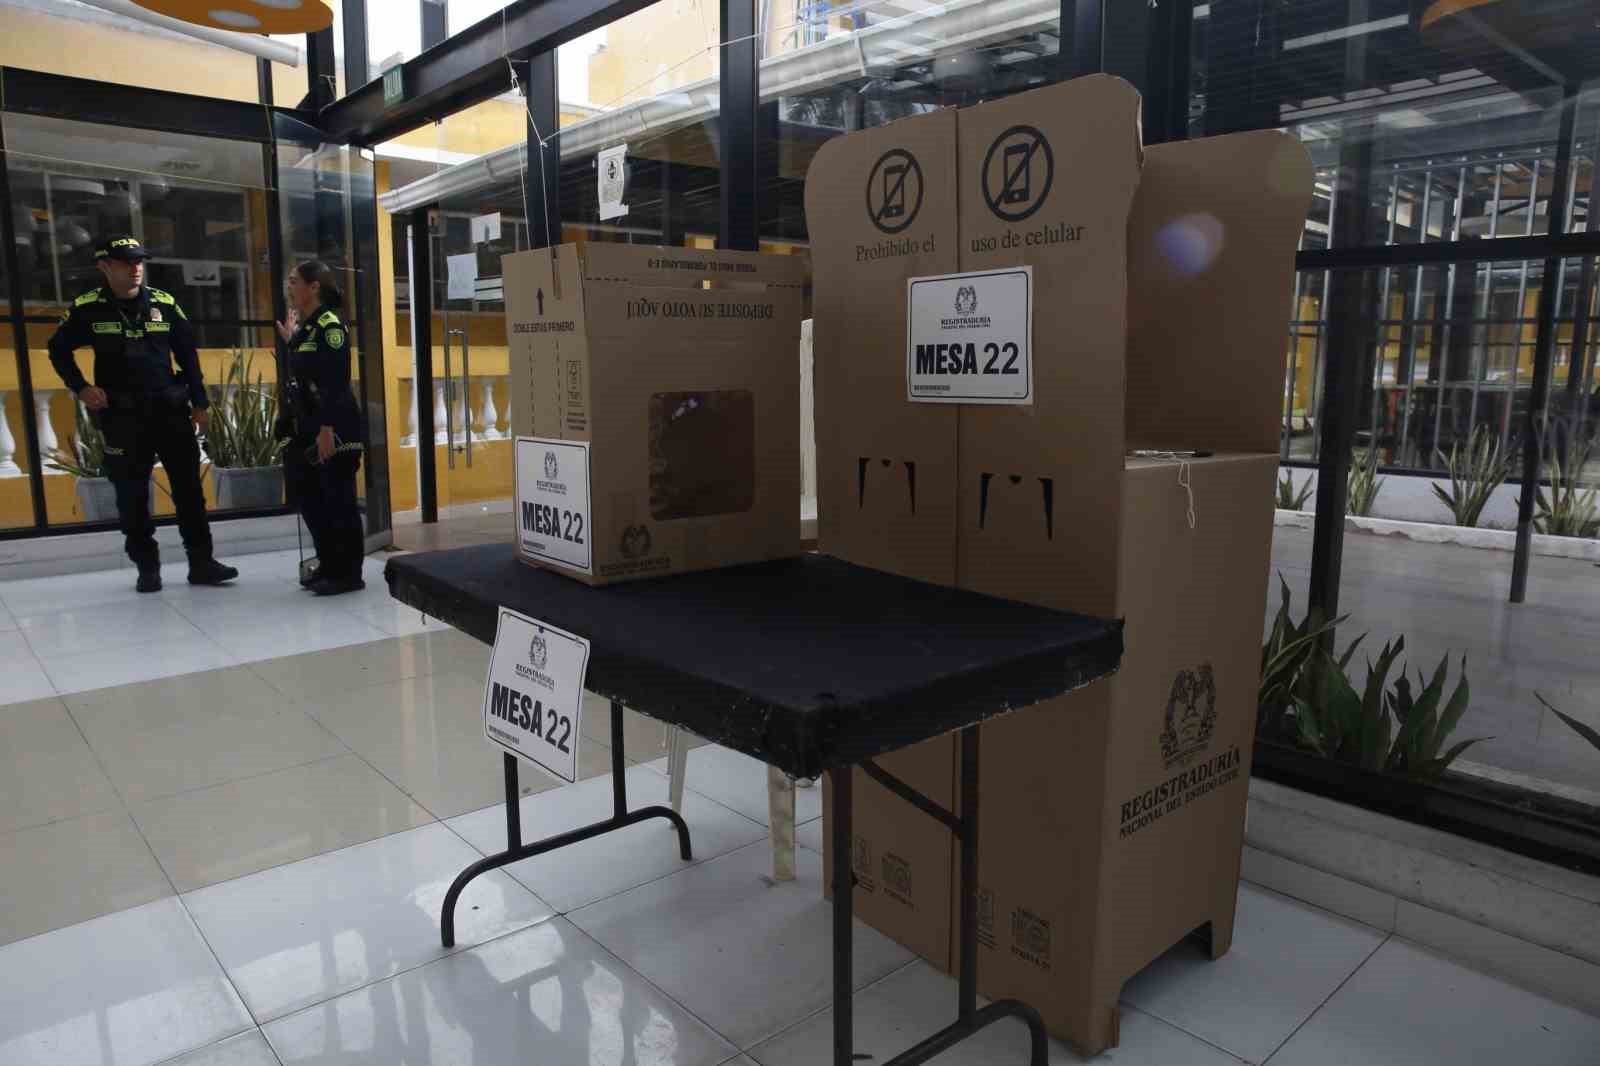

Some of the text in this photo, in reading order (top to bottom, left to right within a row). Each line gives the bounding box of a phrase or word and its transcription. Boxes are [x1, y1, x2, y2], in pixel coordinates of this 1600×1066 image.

[856, 222, 1086, 262] Prohibido el uso de celular
[662, 302, 697, 318] VOTO
[699, 303, 715, 318] SU
[718, 303, 774, 320] DEPOSITE
[915, 341, 1020, 375] MESA 22
[521, 501, 584, 545] MESA 22
[490, 682, 571, 754] MESA 22
[1120, 743, 1240, 825] REGISTRADURÍA
